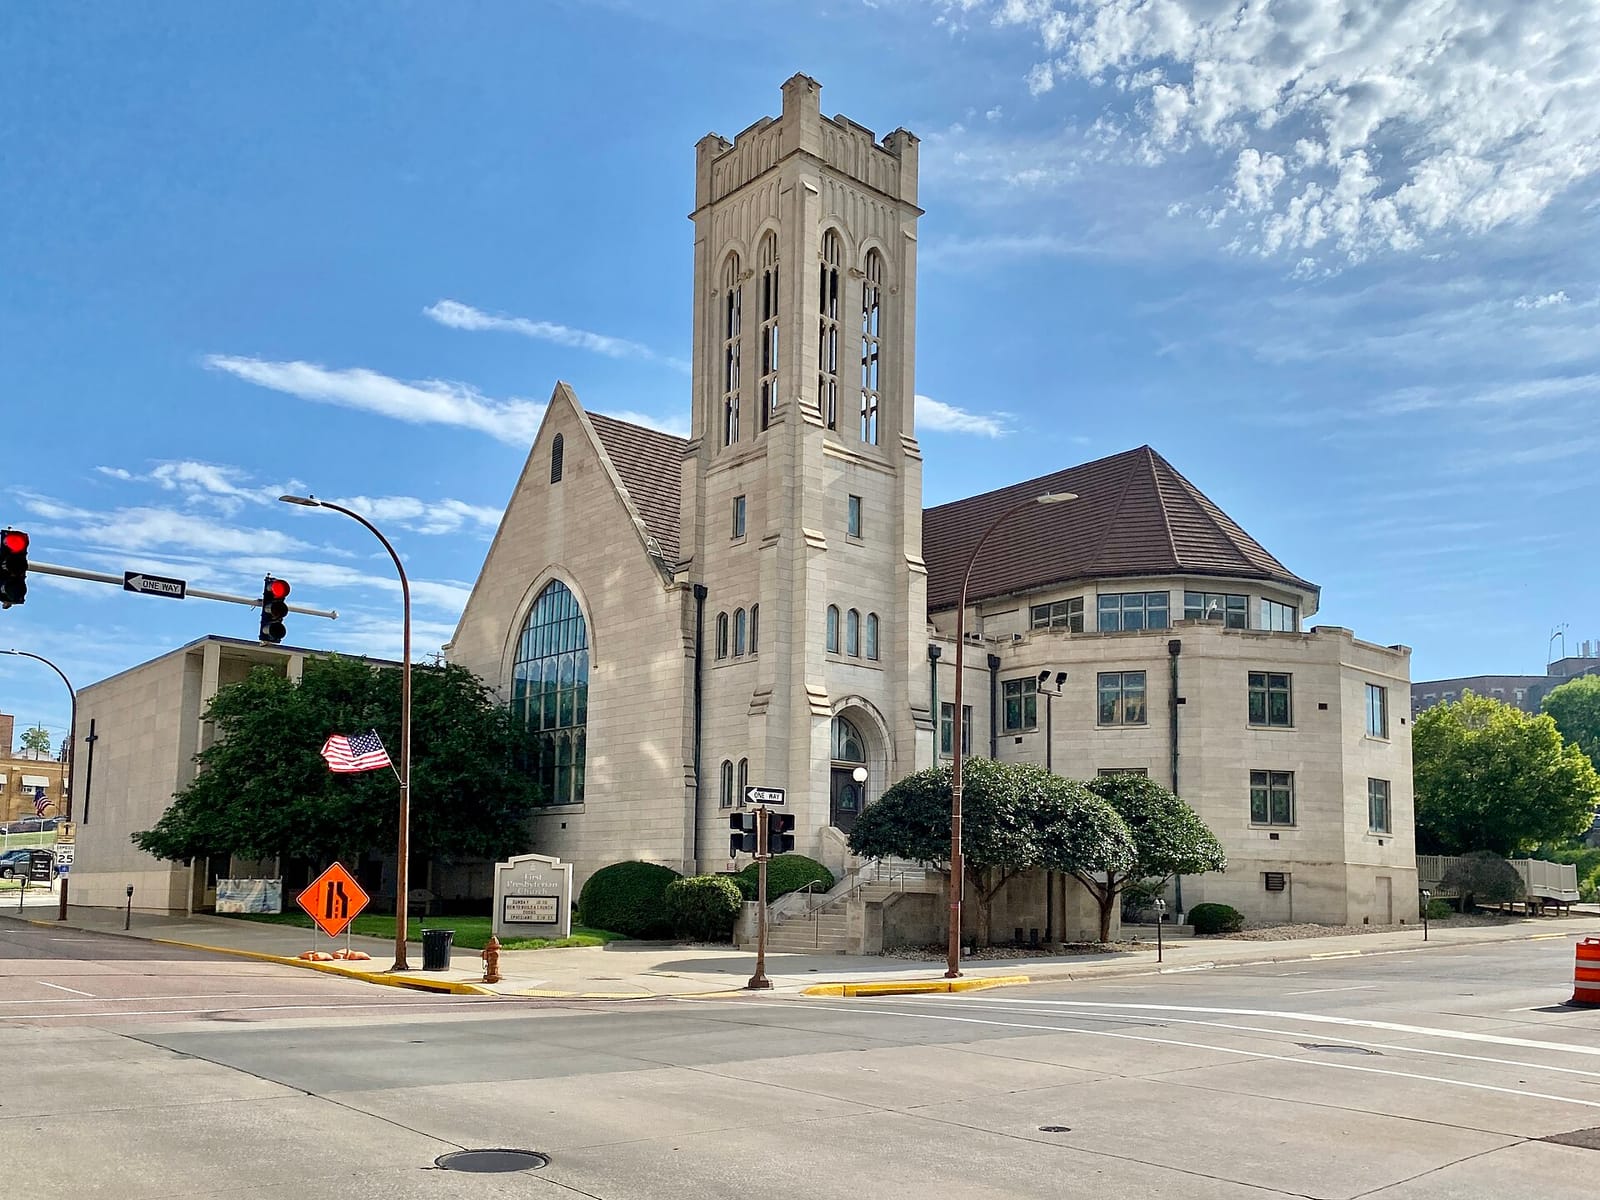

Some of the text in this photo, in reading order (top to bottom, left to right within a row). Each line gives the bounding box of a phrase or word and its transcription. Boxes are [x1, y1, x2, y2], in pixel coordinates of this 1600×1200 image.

[142, 580, 180, 592] ONE WAY
[58, 854, 73, 863] 25
[523, 873, 543, 881] First
[506, 880, 558, 888] Presbyterian
[517, 887, 548, 895] Church
